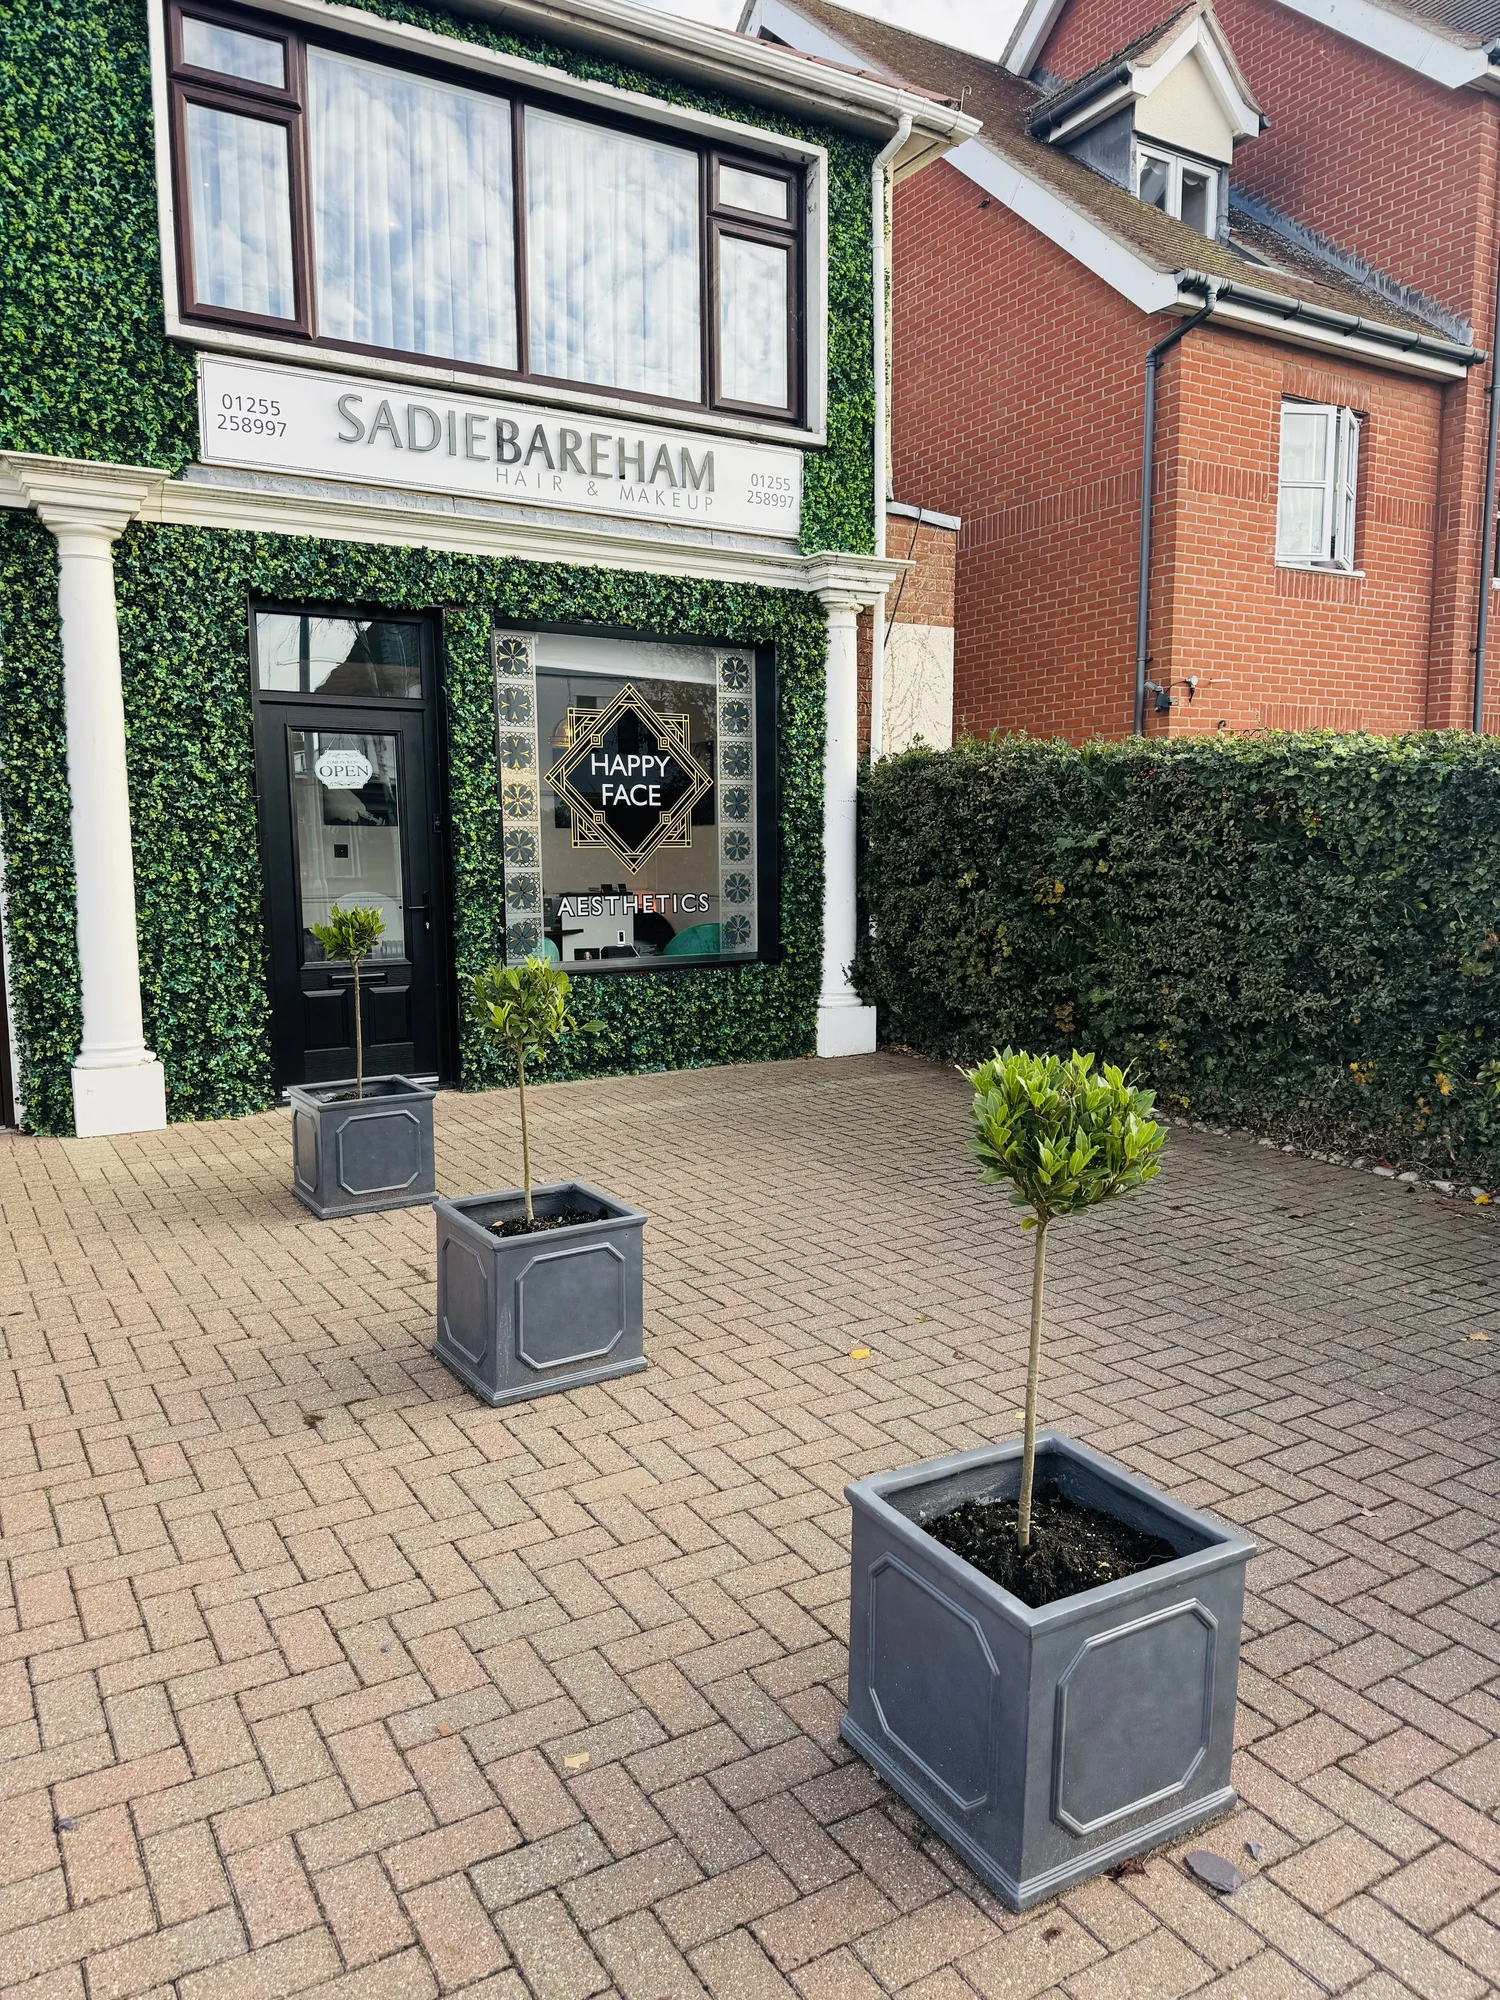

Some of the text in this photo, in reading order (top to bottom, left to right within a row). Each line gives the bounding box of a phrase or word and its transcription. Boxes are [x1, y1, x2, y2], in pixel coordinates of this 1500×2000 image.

[222, 393, 281, 416] 01255
[217, 413, 287, 437] 258997
[496, 466, 713, 511] HAIR & MAKEUP
[751, 473, 791, 491] 01255
[747, 489, 794, 509] 258997
[319, 765, 369, 777] OPEN
[591, 753, 671, 777] HAPPY
[601, 783, 662, 807] FACE
[557, 893, 710, 917] AESTHETICS
